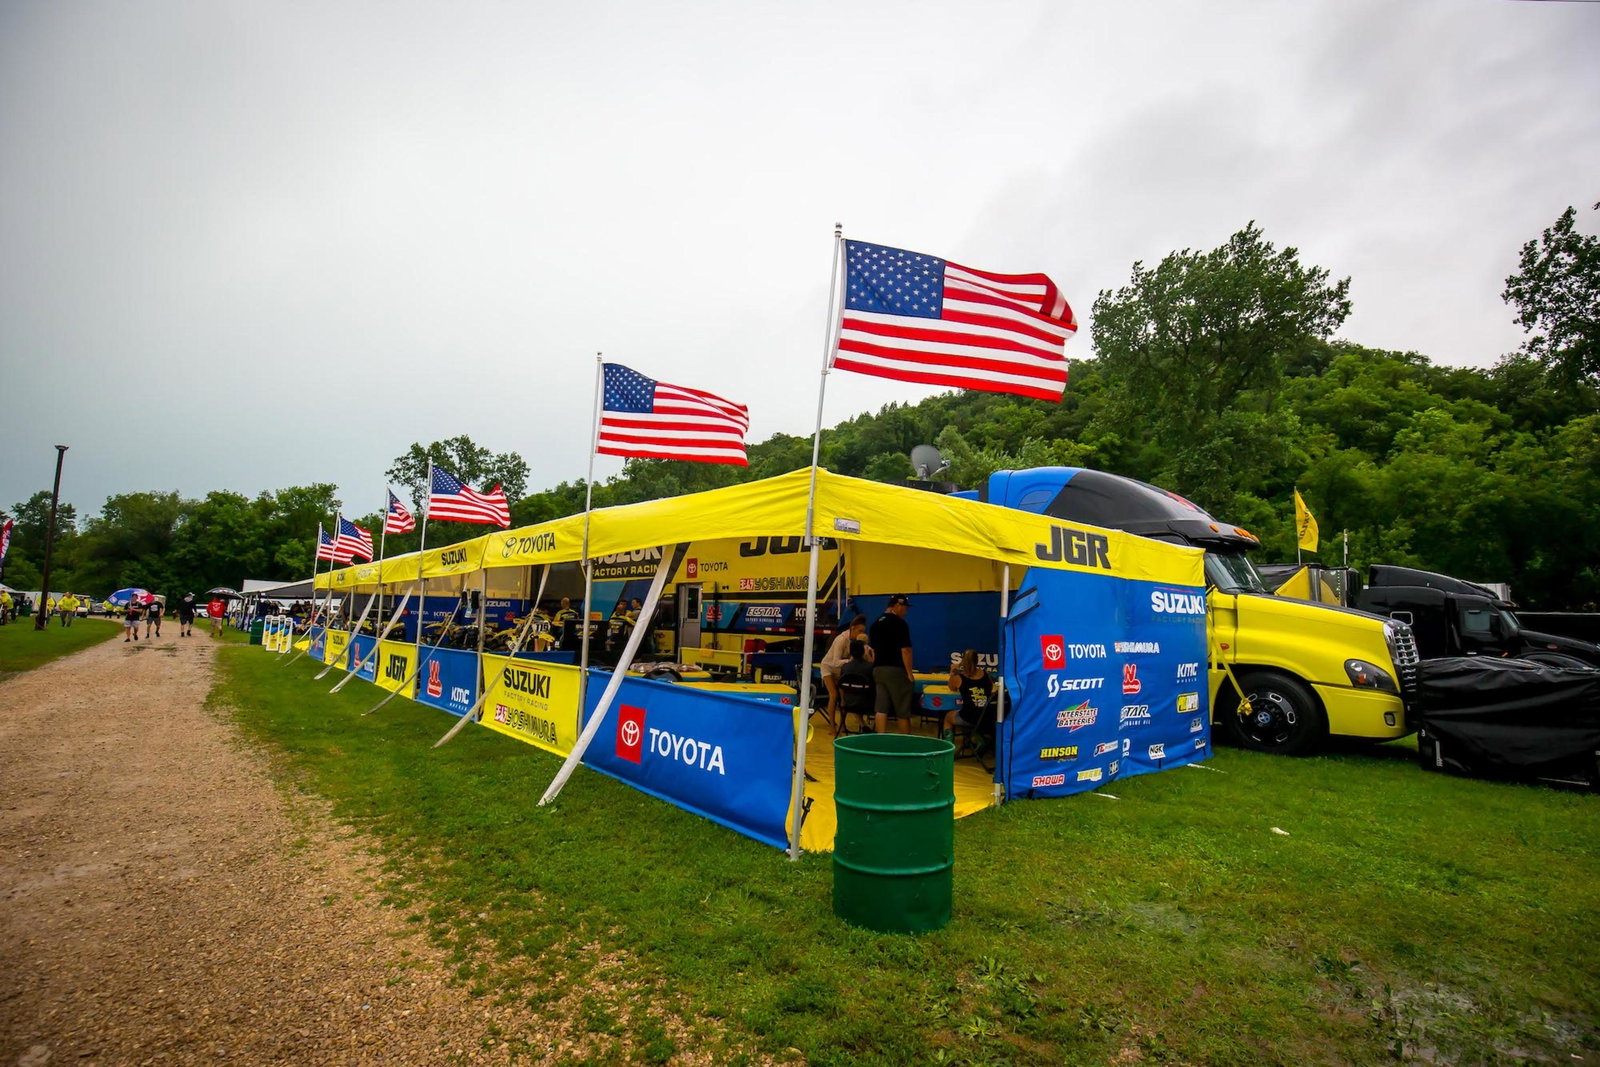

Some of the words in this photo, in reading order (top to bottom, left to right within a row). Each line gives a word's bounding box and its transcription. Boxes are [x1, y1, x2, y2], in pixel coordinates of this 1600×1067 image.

[517, 532, 556, 554] TOYOTA
[1035, 524, 1112, 570] JGR
[441, 547, 468, 565] SUZUKI
[631, 563, 660, 575] RACIN
[700, 561, 729, 573] TOYOTA
[755, 575, 820, 591] YOSHIMUR
[1151, 590, 1206, 615] SUZUKI
[1068, 644, 1107, 659] TOYOTA
[385, 653, 408, 683] JGR
[1177, 662, 1199, 678] KMC
[503, 667, 551, 699] SUZUKI
[1060, 677, 1105, 691] SCOTT
[450, 686, 471, 705] KMC
[505, 706, 559, 745] YOSHIMURA
[649, 727, 726, 776] TOYOTA
[1040, 746, 1078, 758] HINSON
[1032, 774, 1065, 787] SHOWA
